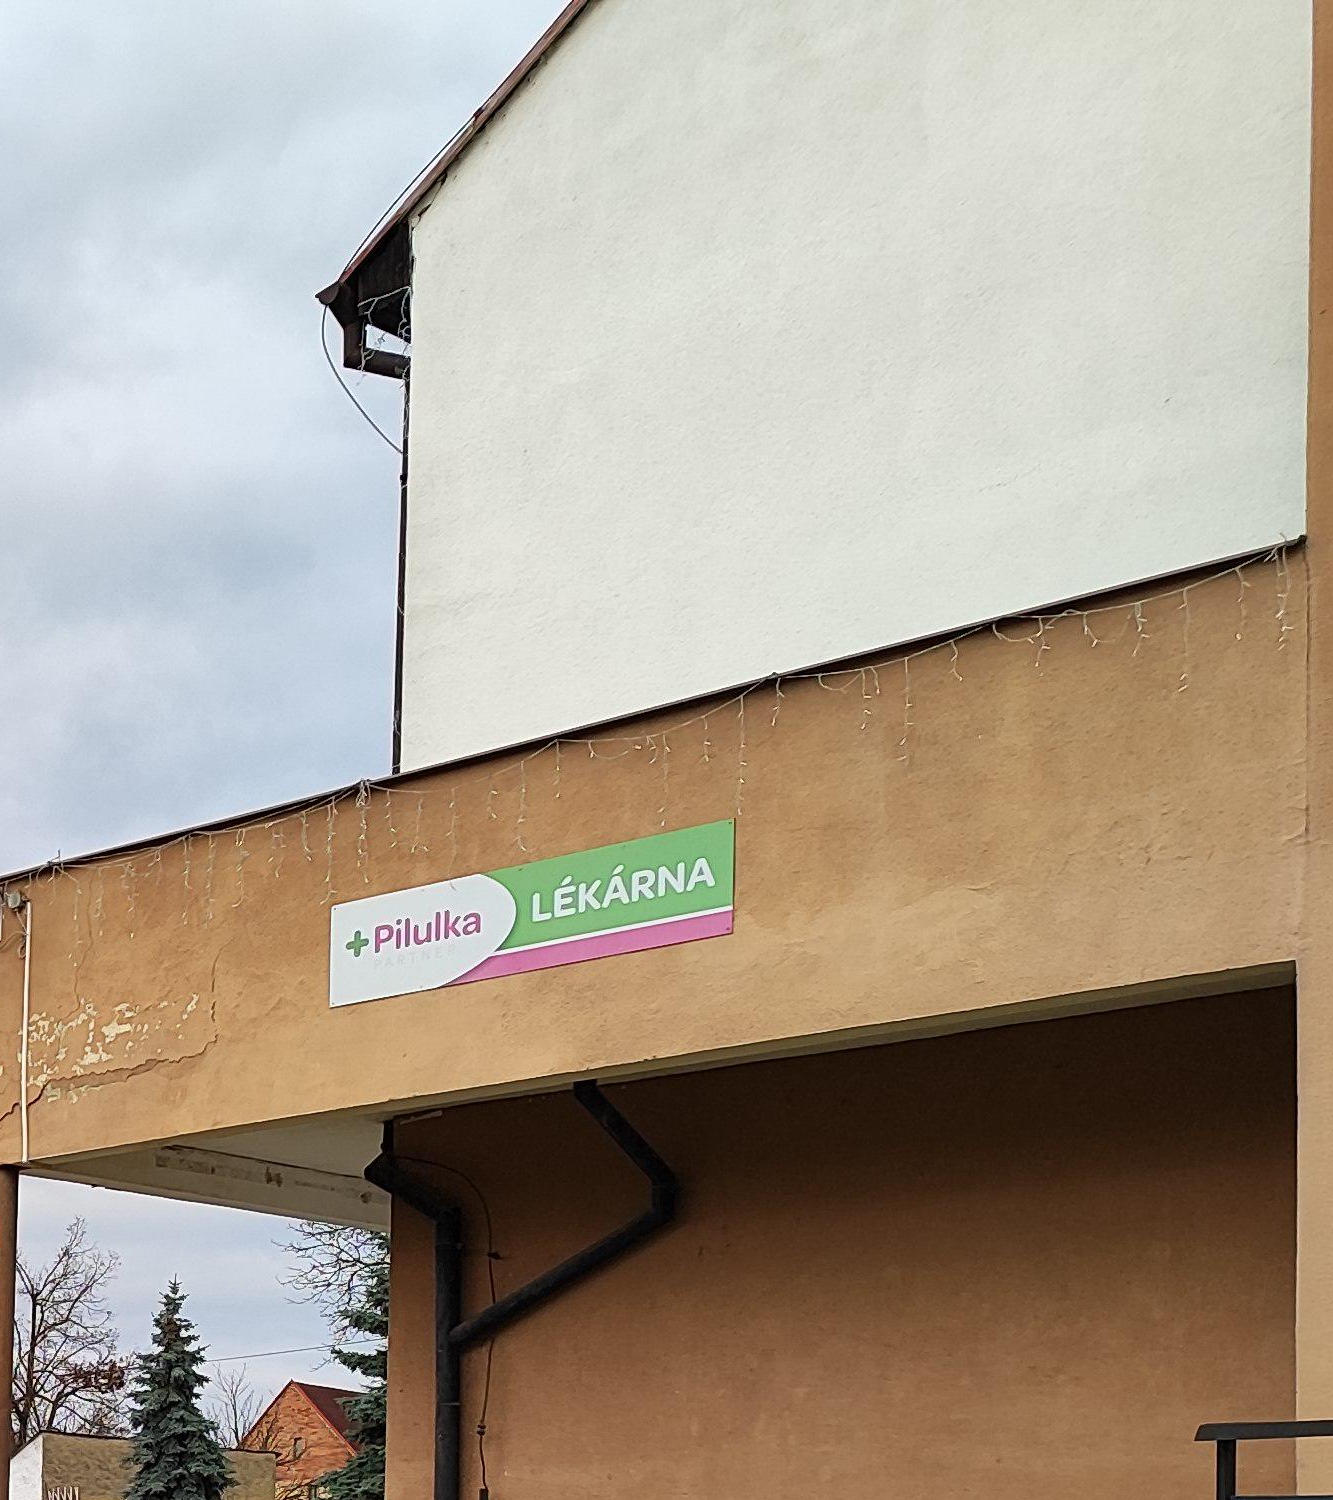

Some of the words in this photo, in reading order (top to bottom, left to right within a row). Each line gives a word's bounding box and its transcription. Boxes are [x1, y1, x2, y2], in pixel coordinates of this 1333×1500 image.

[374, 909, 481, 954] Pilulka
[532, 857, 716, 922] LÉKÁRNA
[373, 944, 455, 969] PARTNER
